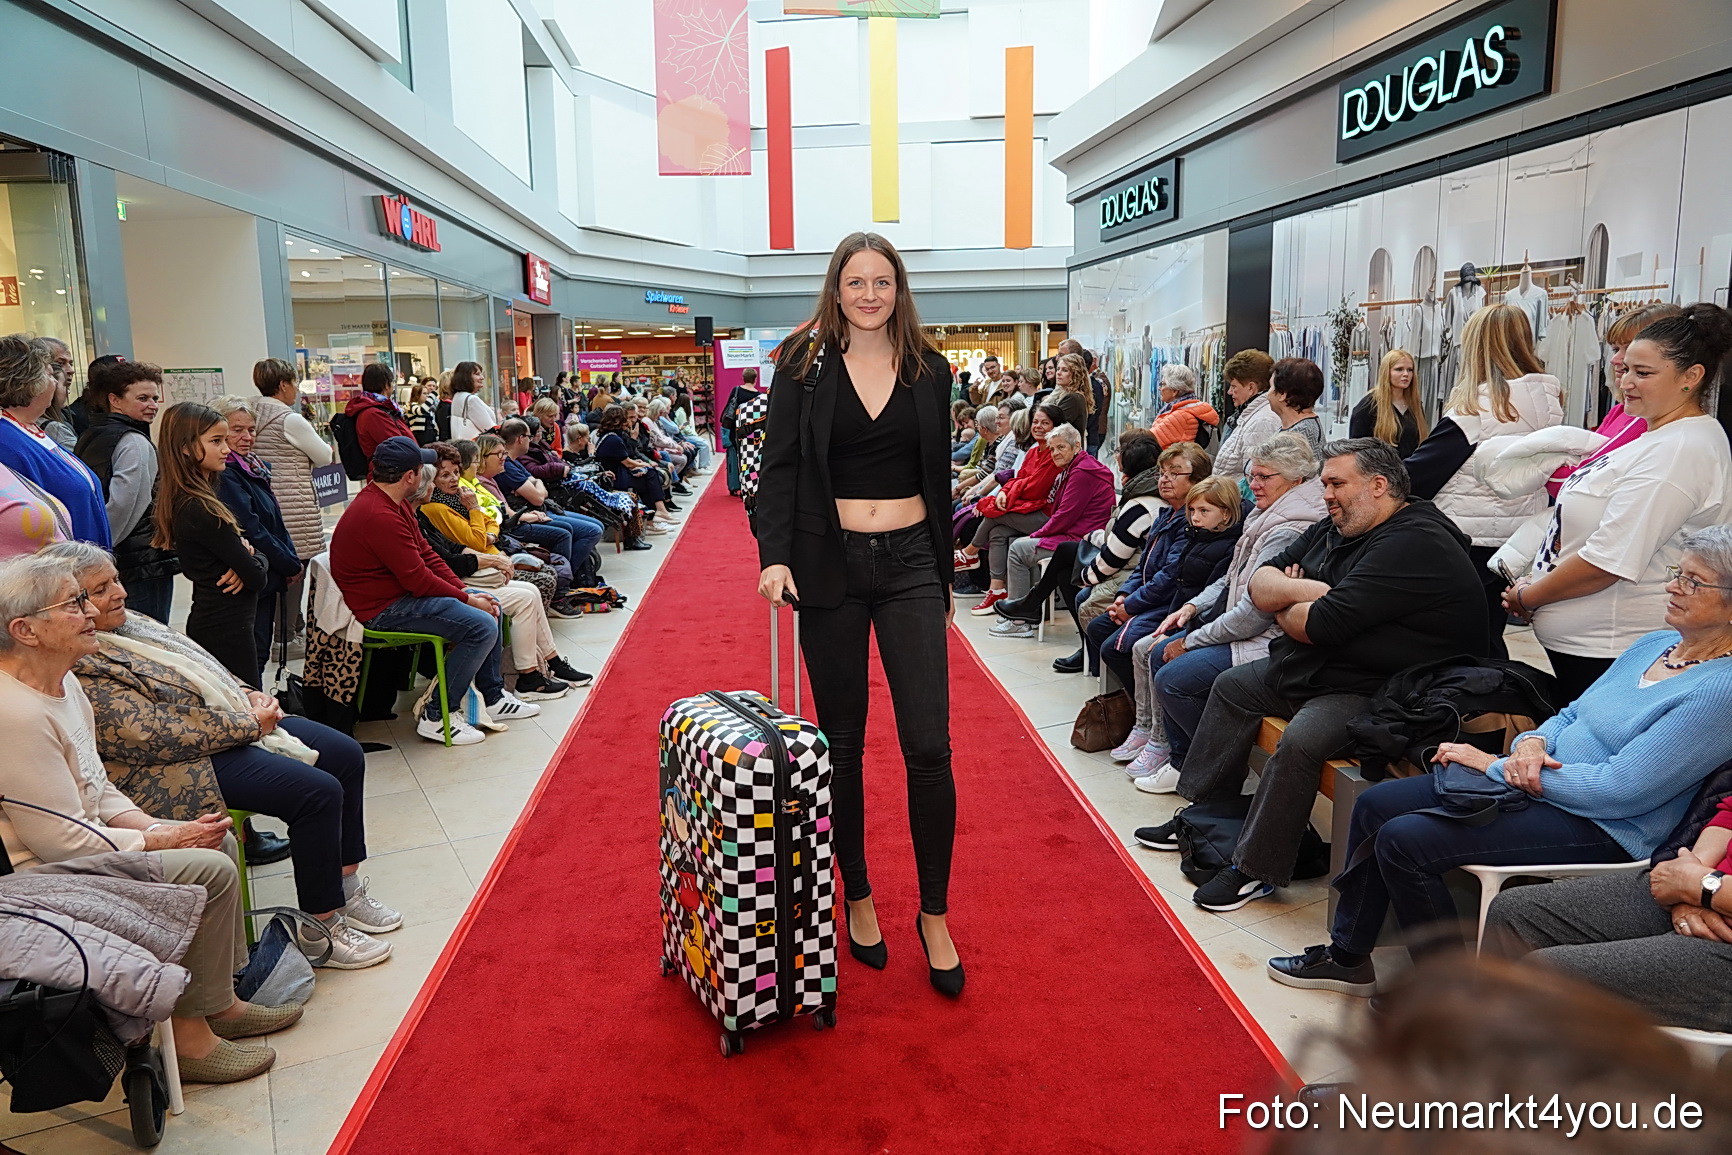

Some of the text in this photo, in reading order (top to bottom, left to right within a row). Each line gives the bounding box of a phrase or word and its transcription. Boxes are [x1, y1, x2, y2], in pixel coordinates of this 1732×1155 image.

[1342, 25, 1505, 140] DOUGLAS
[1100, 176, 1159, 230] DOUGLAS
[381, 194, 441, 252] WÖHRL
[645, 290, 684, 304] Spielwaren
[941, 348, 987, 363] ERO
[314, 473, 333, 489] MARIE
